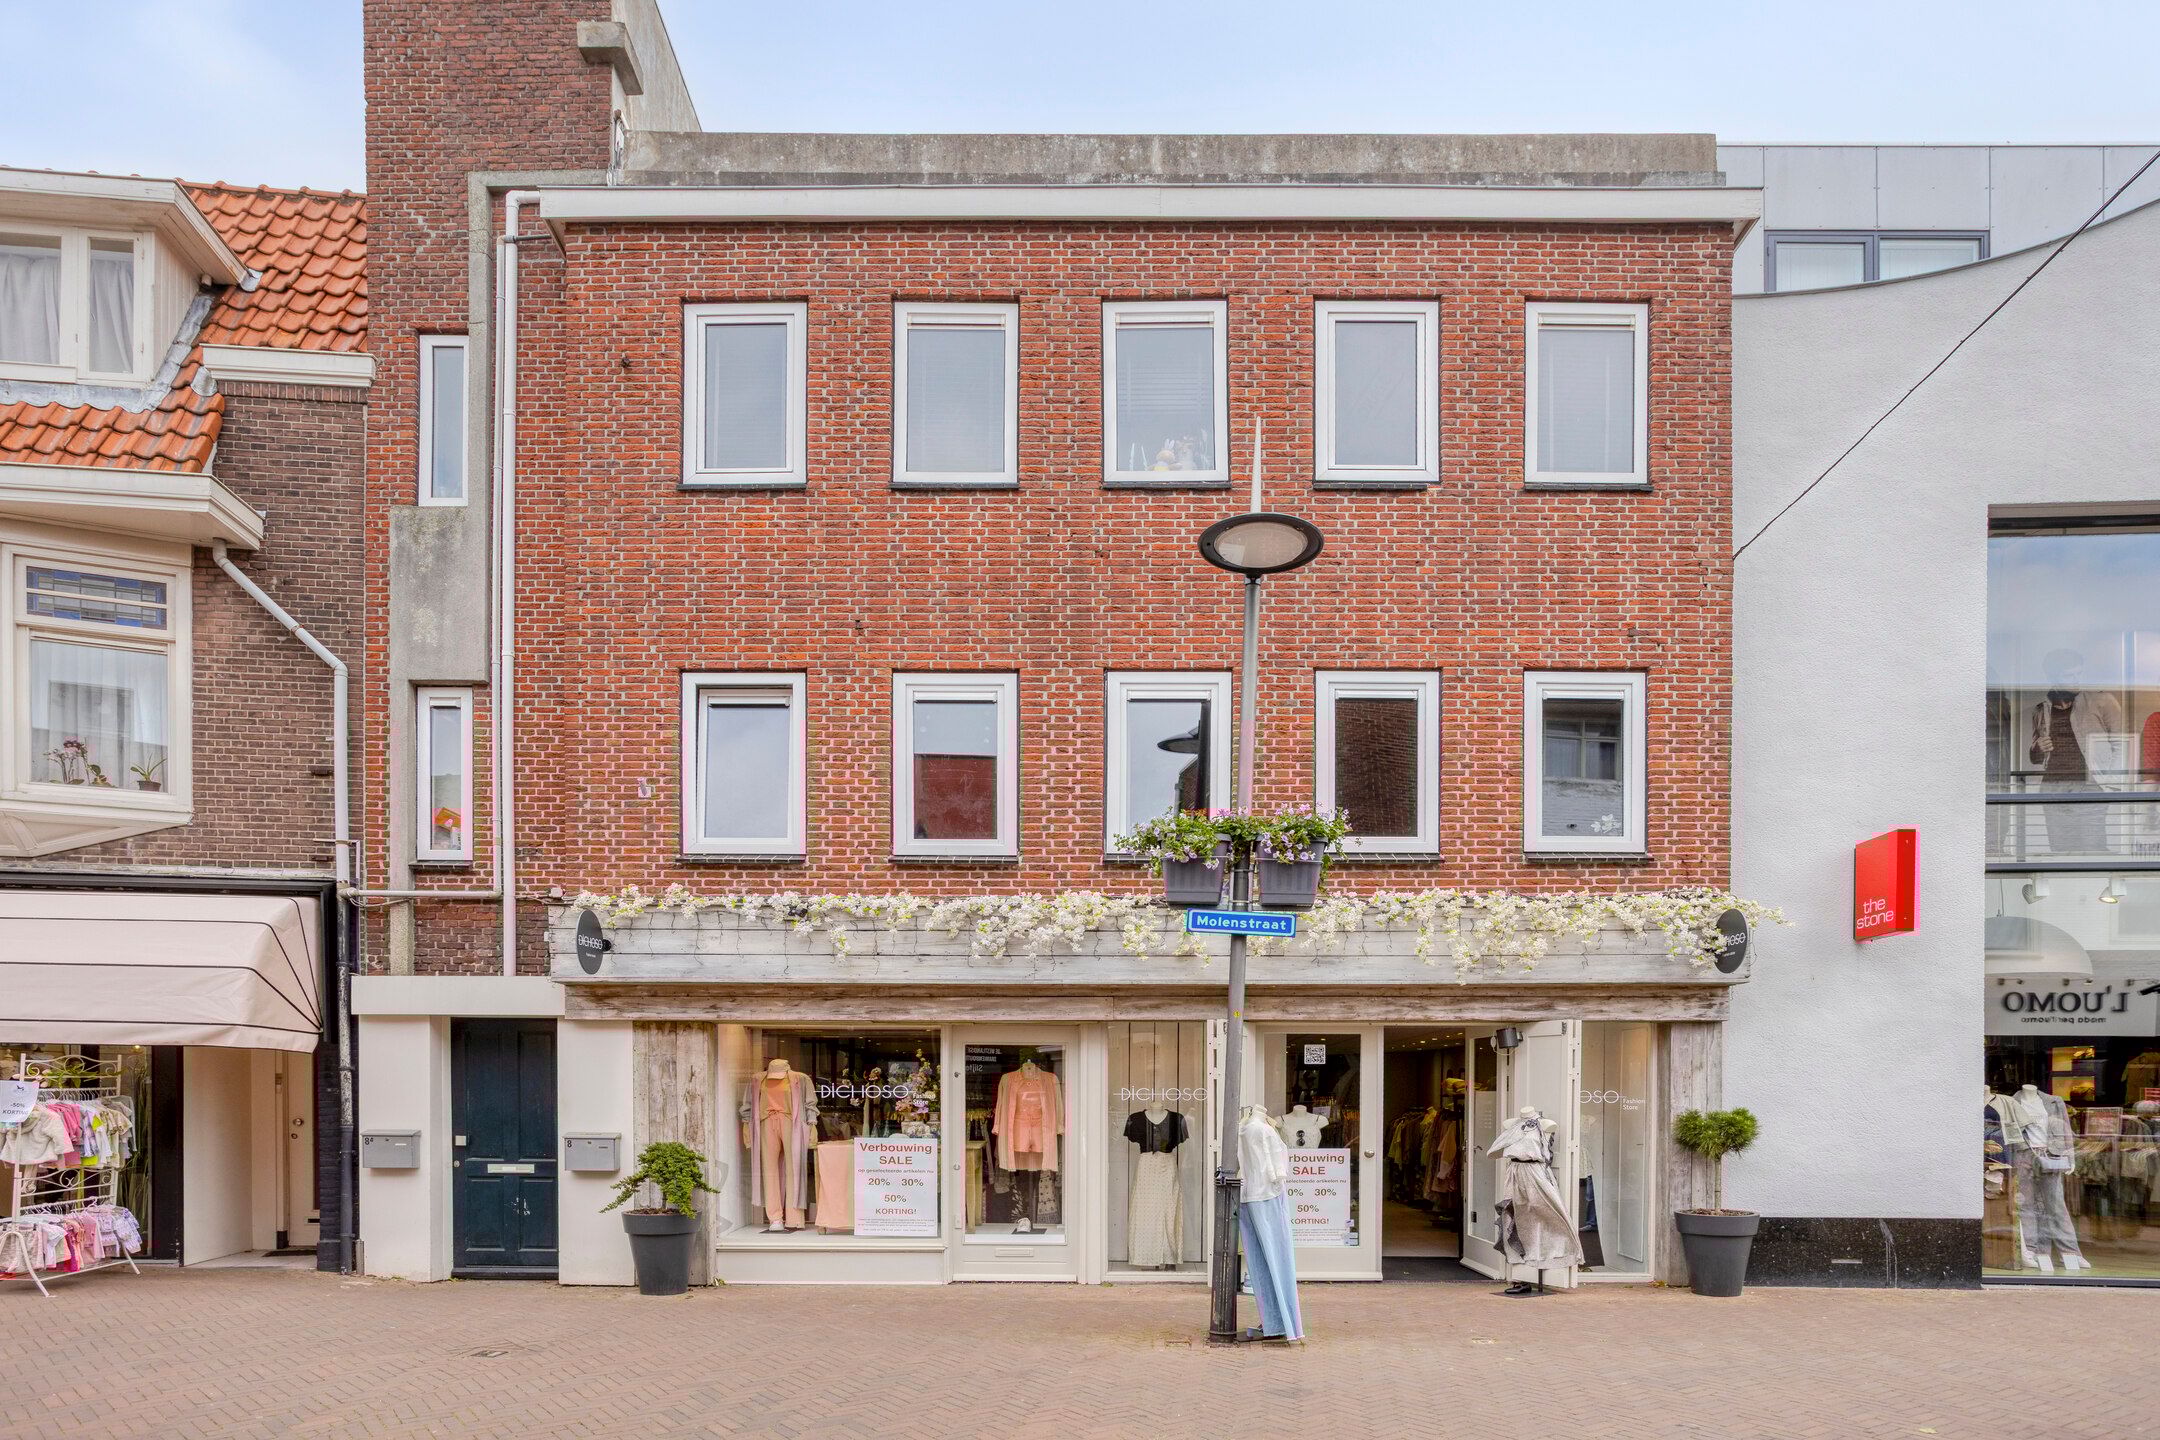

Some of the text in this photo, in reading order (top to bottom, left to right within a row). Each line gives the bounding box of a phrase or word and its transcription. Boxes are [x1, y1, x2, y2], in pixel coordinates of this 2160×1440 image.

[1862, 898, 1886, 914] the
[1196, 915, 1287, 931] Molenstraat
[1856, 910, 1894, 929] stone
[566, 1139, 573, 1148] 8
[859, 1143, 932, 1155] Verbouwing
[879, 1156, 913, 1165] SALE
[1288, 1154, 1345, 1165] rbouwing
[1292, 1166, 1326, 1175] SALE
[868, 1178, 924, 1187] 20% 30%
[1287, 1188, 1337, 1197] 0% 30%
[884, 1194, 907, 1203] 50%
[1297, 1204, 1320, 1213] 50%
